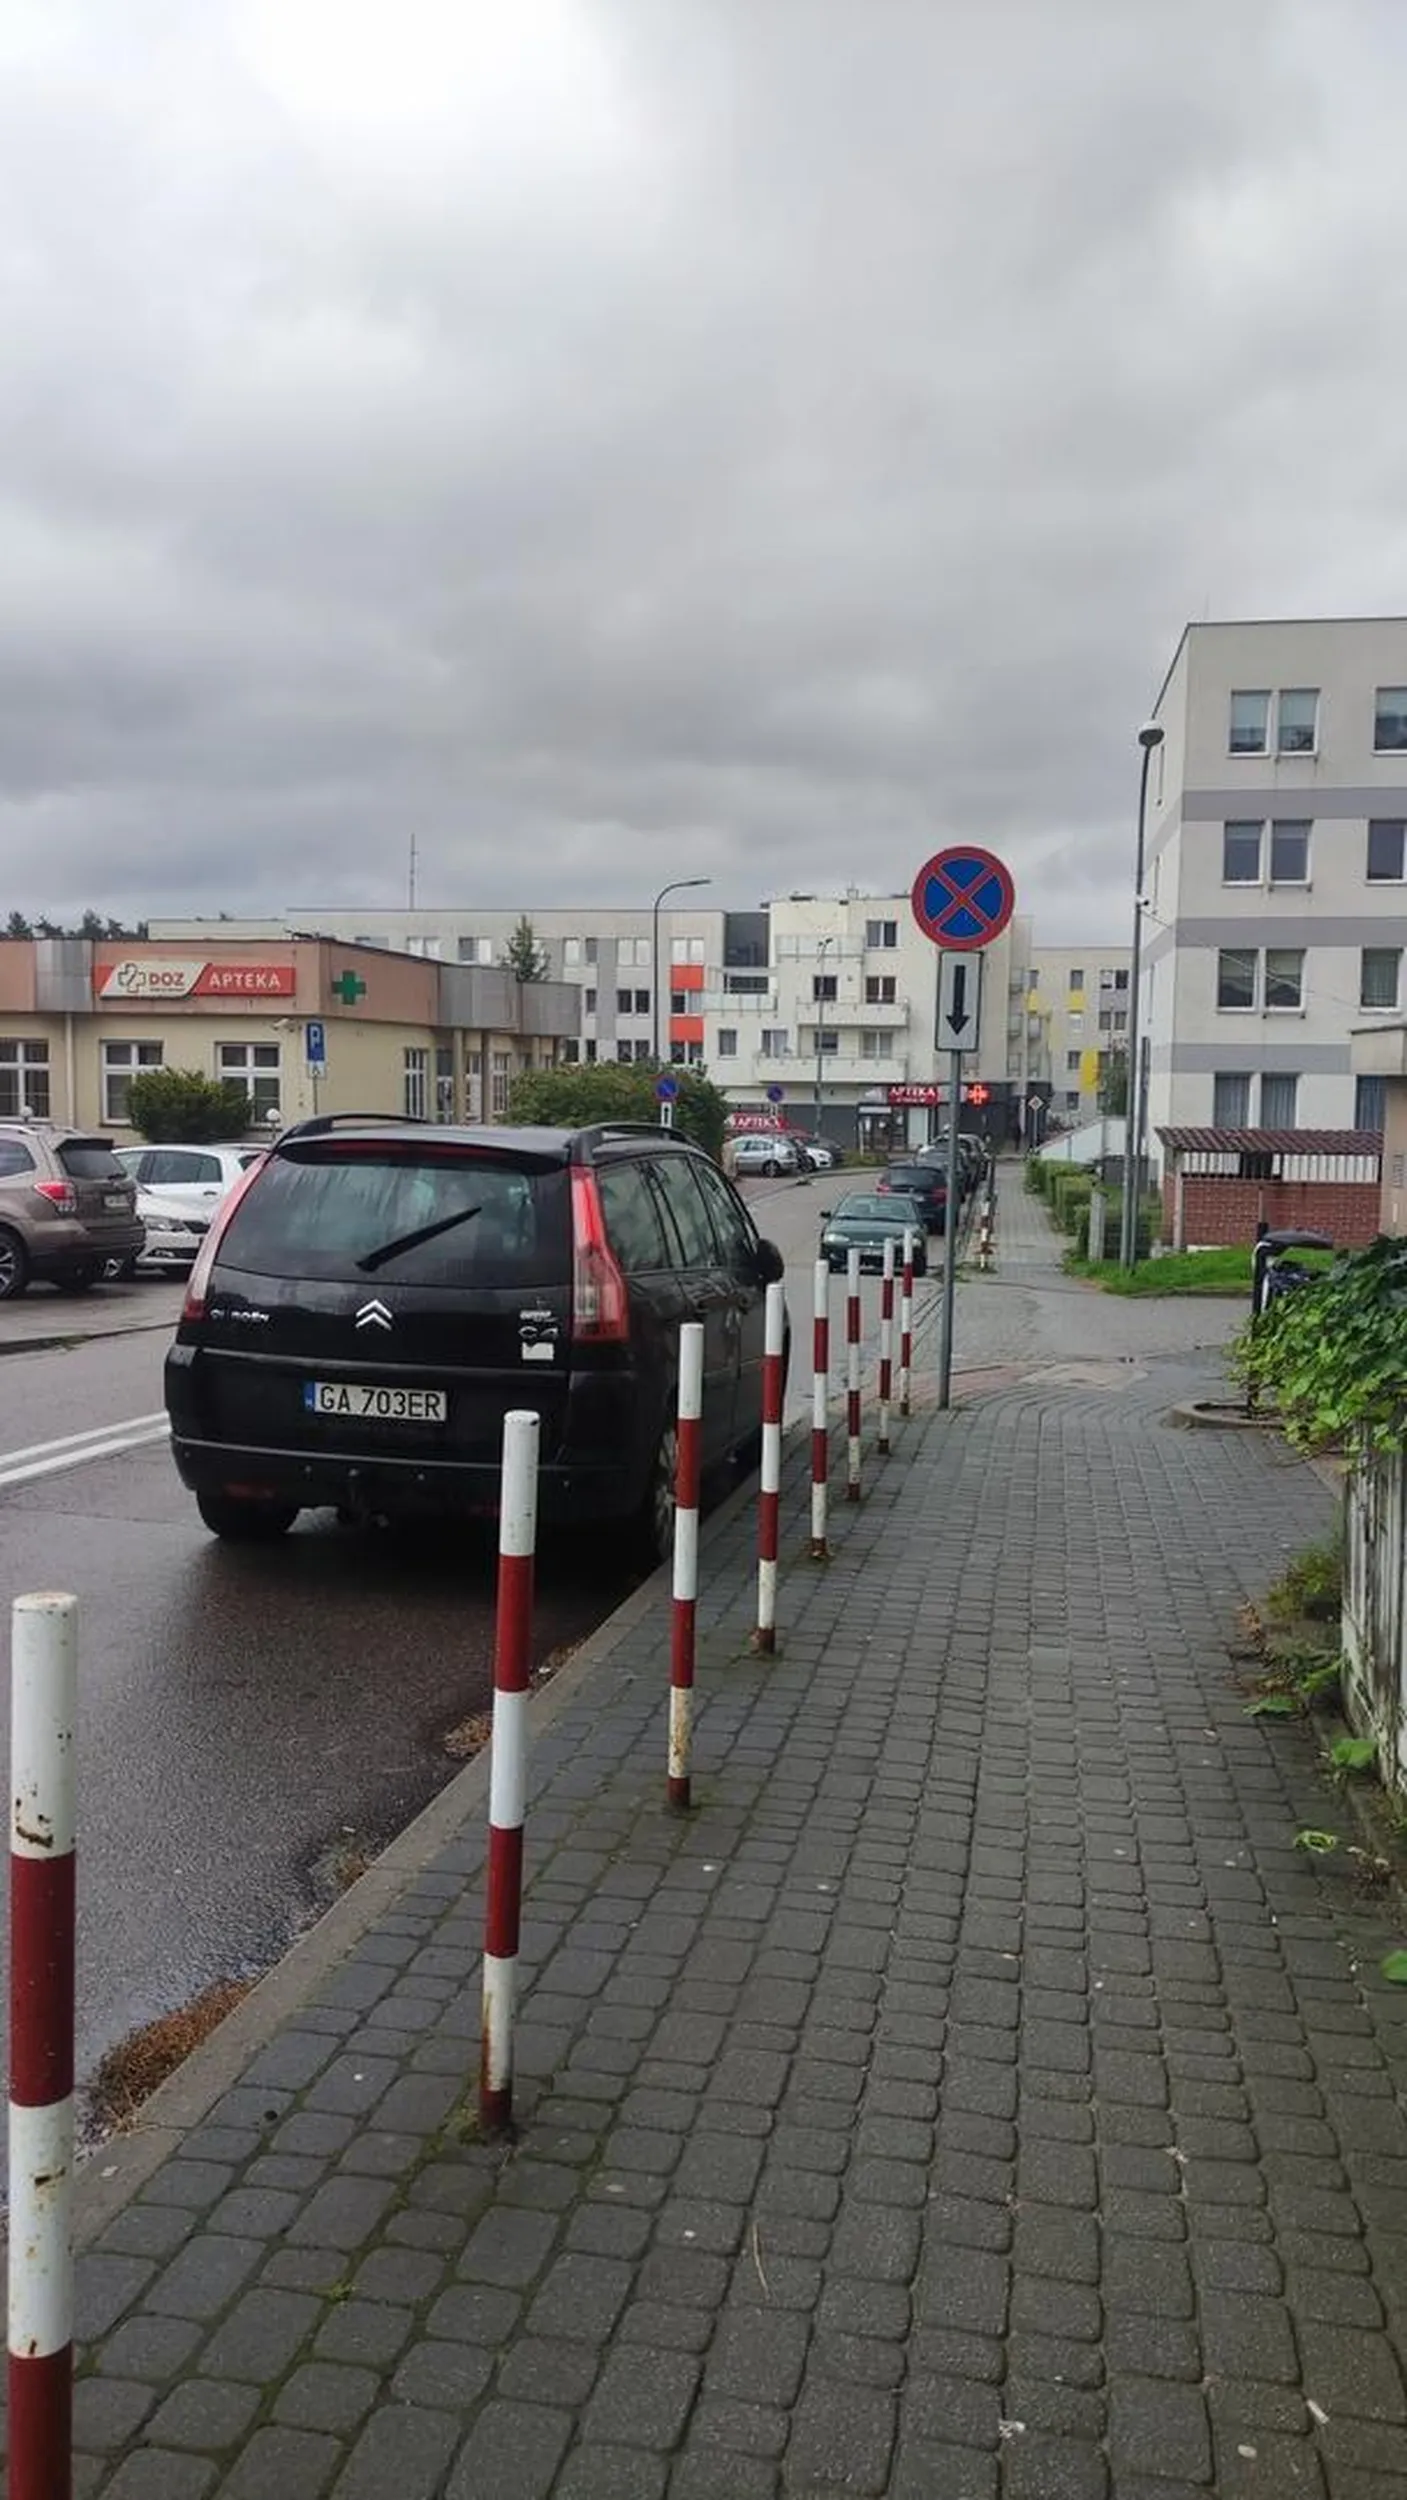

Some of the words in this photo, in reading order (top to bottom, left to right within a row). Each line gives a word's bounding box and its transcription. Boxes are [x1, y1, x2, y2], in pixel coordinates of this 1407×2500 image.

[149, 972, 184, 986] DOZ
[209, 972, 281, 989] APTEKA
[310, 1025, 321, 1049] P
[890, 1085, 936, 1097] APTEKA
[736, 1115, 781, 1128] APTEKA
[320, 1386, 350, 1411] GA
[361, 1388, 441, 1418] 703ER
